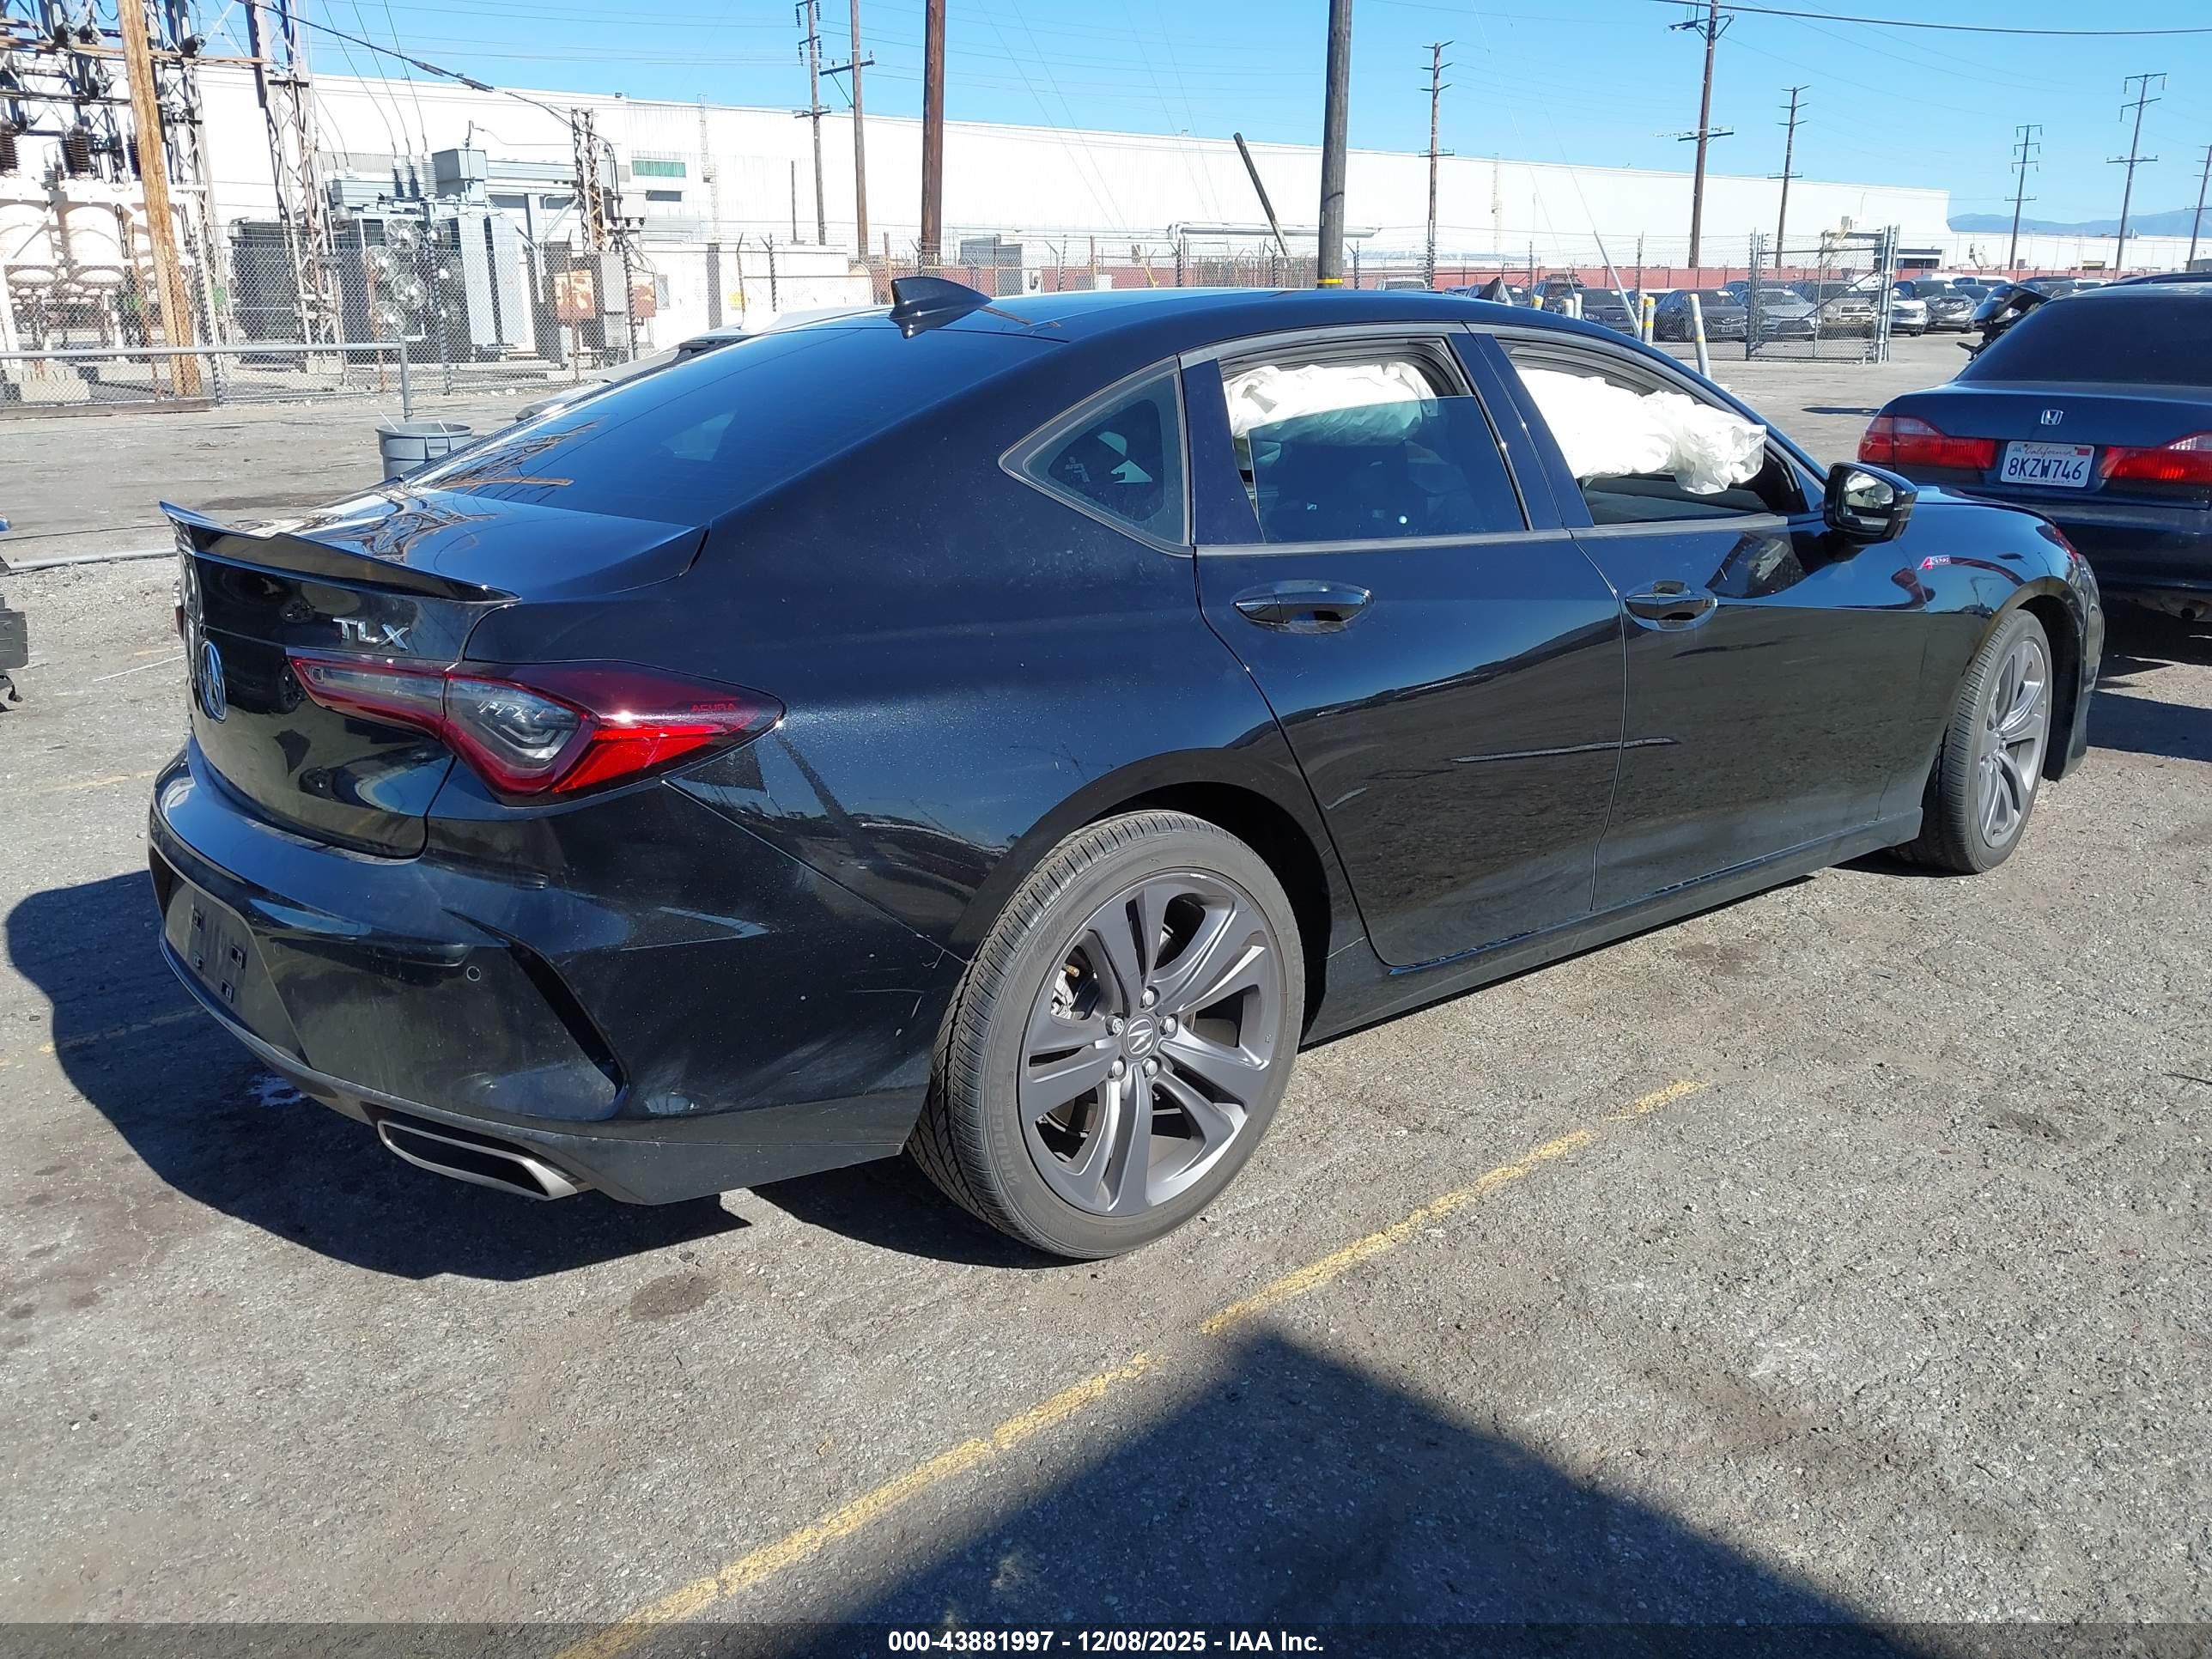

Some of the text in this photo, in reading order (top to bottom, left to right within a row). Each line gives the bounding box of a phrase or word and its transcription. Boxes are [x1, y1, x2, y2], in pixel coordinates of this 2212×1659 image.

[2008, 457, 2085, 480] 8KZW746
[332, 617, 410, 650] TLX
[690, 703, 736, 712] ACURA
